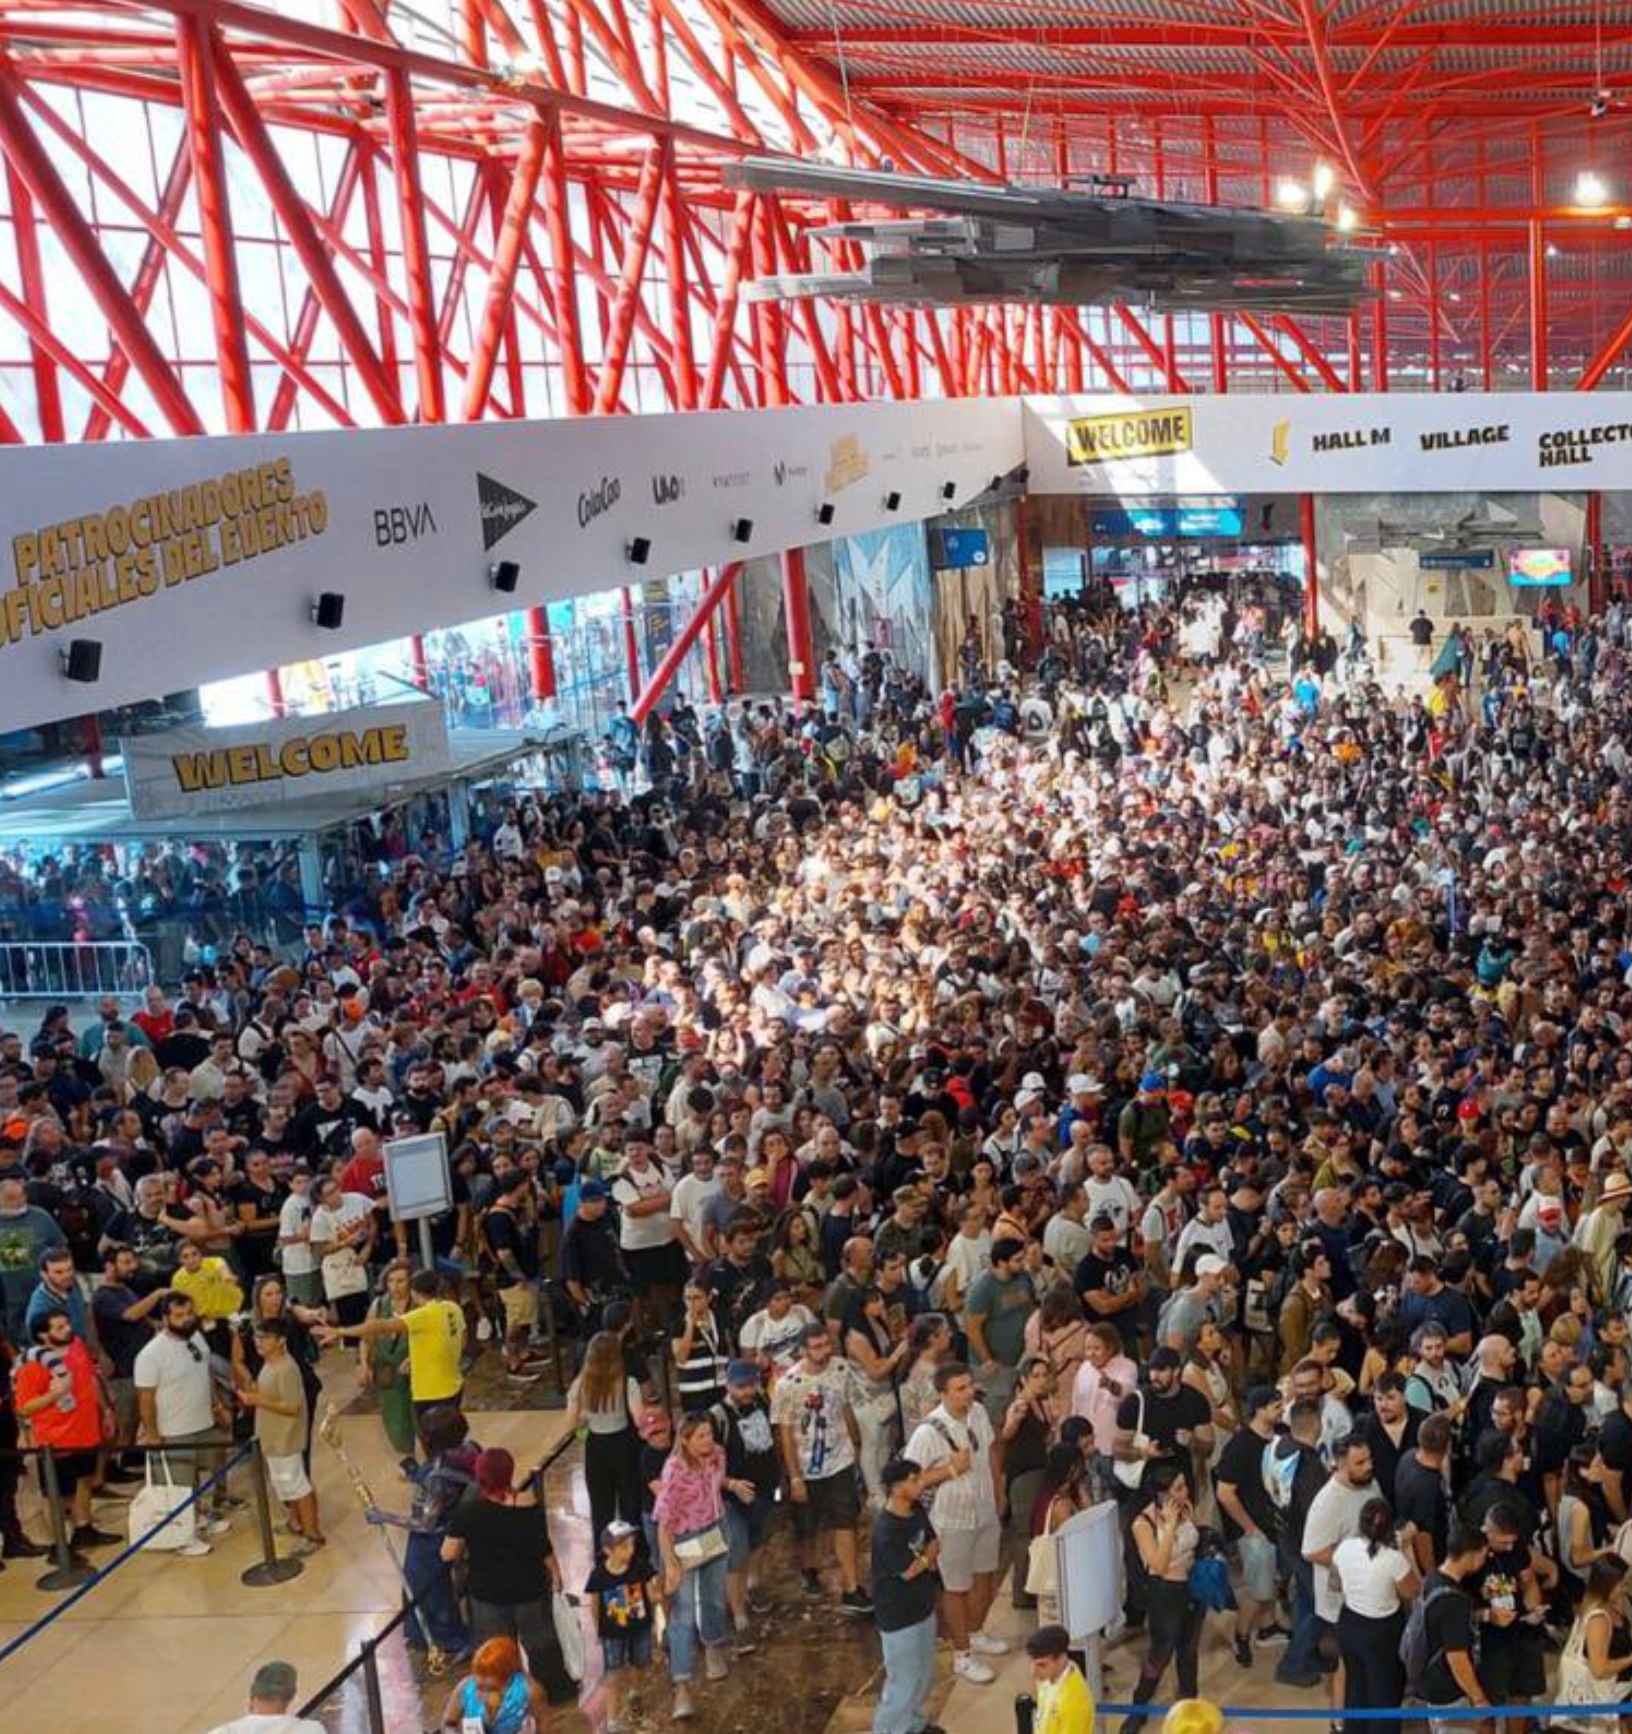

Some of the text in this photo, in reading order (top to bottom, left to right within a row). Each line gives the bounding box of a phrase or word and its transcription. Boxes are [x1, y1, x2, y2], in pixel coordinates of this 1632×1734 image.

[1076, 416, 1185, 454] WELCOME
[1312, 427, 1391, 452] HALL M
[1420, 424, 1510, 450] VILLAGE
[1539, 445, 1593, 468] HALL
[12, 457, 295, 586] PATROCINADORES
[161, 529, 219, 588] DEL
[219, 490, 328, 566] EVENTO
[374, 502, 437, 546] BBVA
[172, 724, 408, 793] WELCOME
